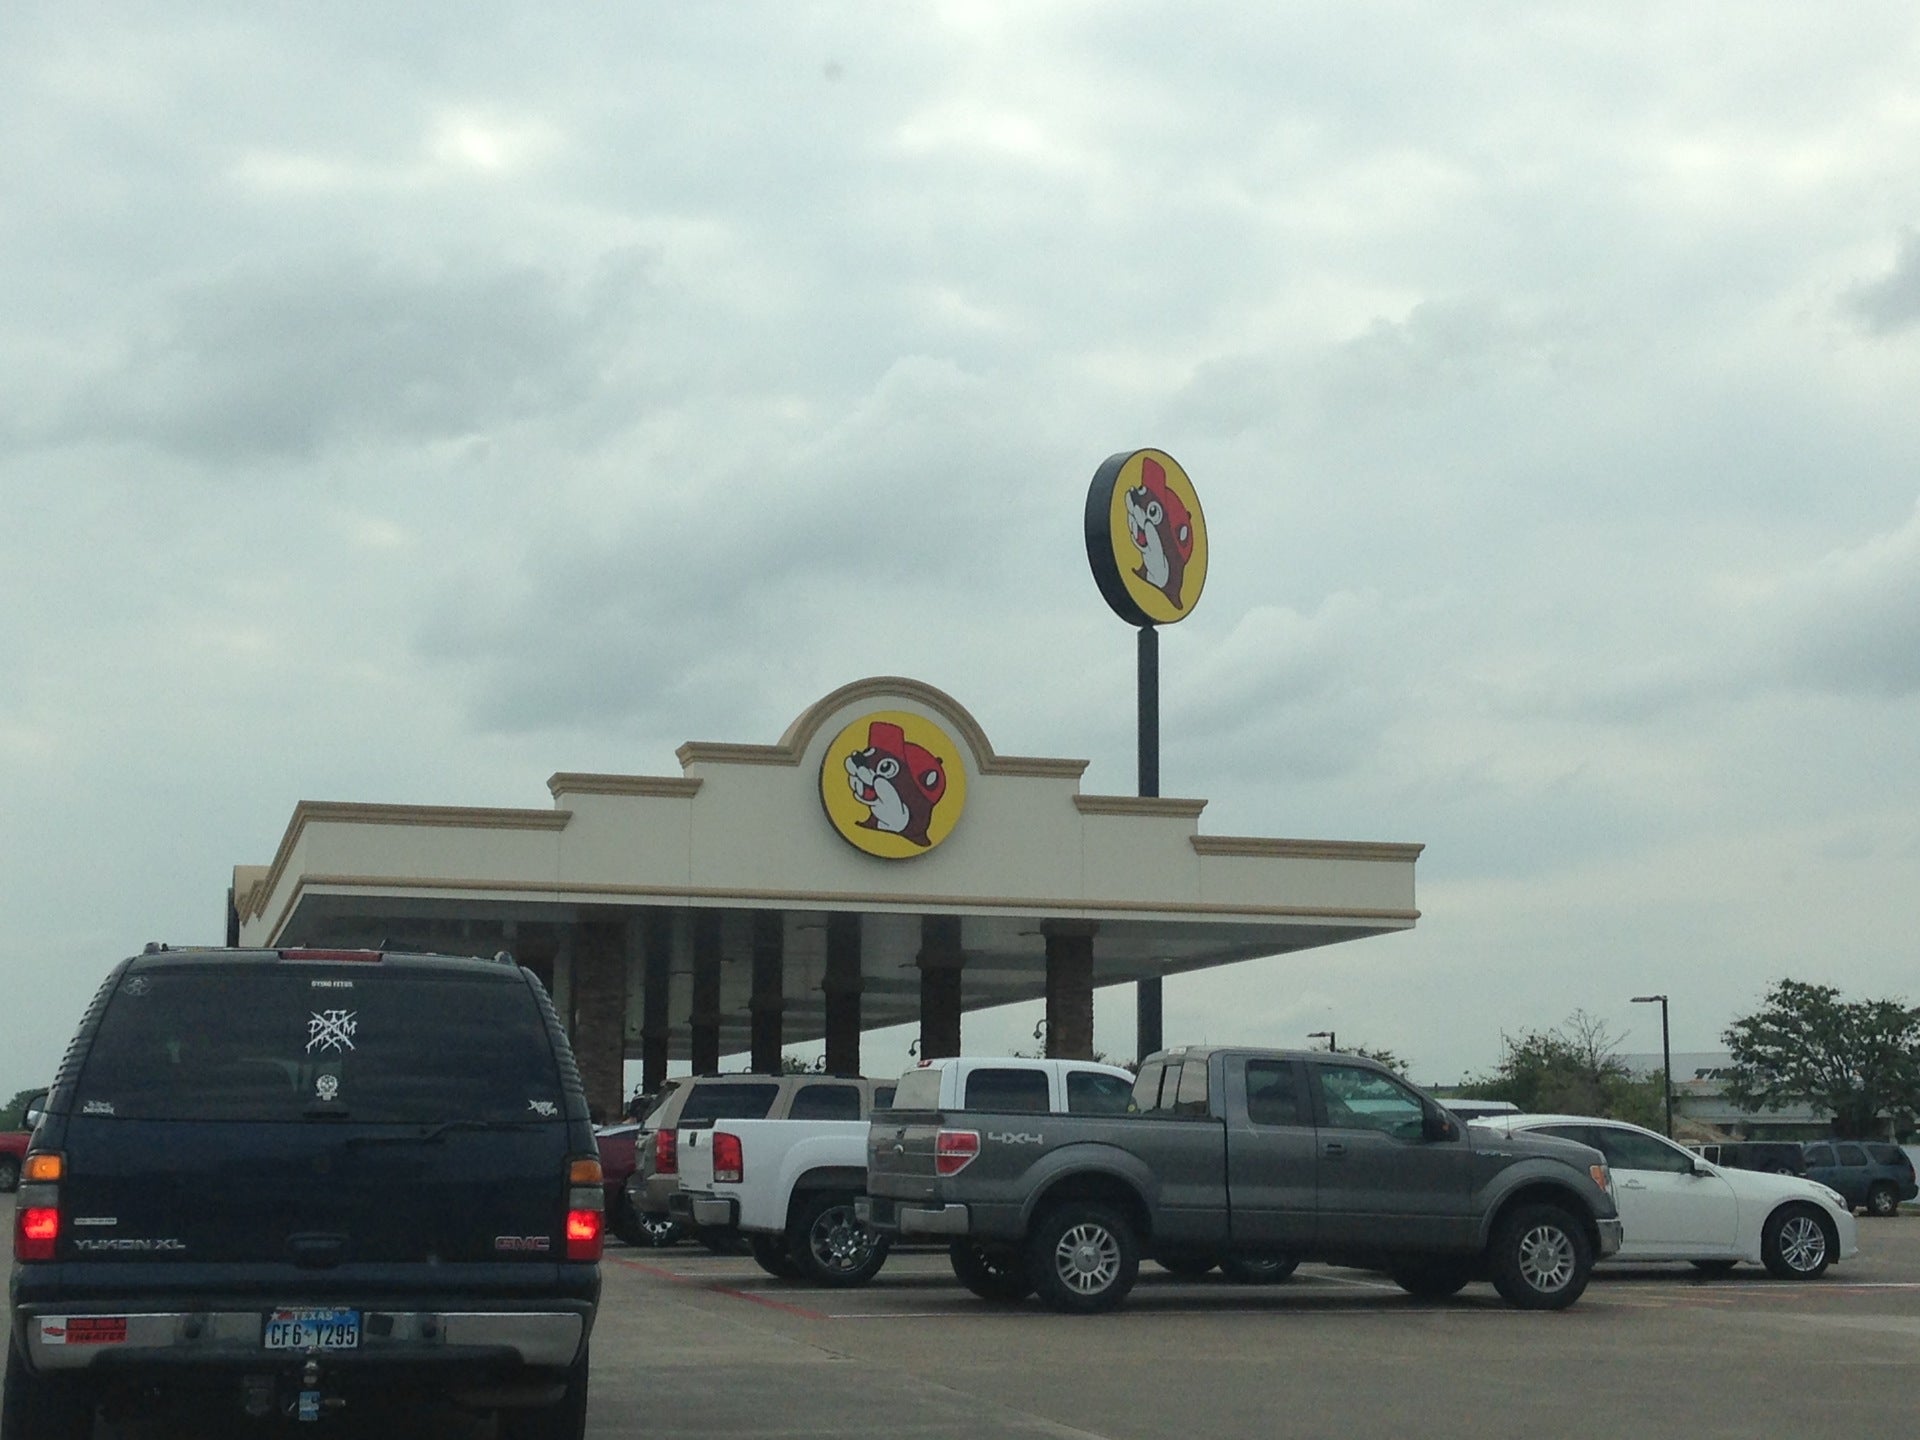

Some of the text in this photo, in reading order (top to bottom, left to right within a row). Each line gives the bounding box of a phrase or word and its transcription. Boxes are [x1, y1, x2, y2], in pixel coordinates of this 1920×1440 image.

[74, 1239, 186, 1250] YUKON XL
[495, 1236, 550, 1250] GMC
[293, 1311, 333, 1321] TEXAS
